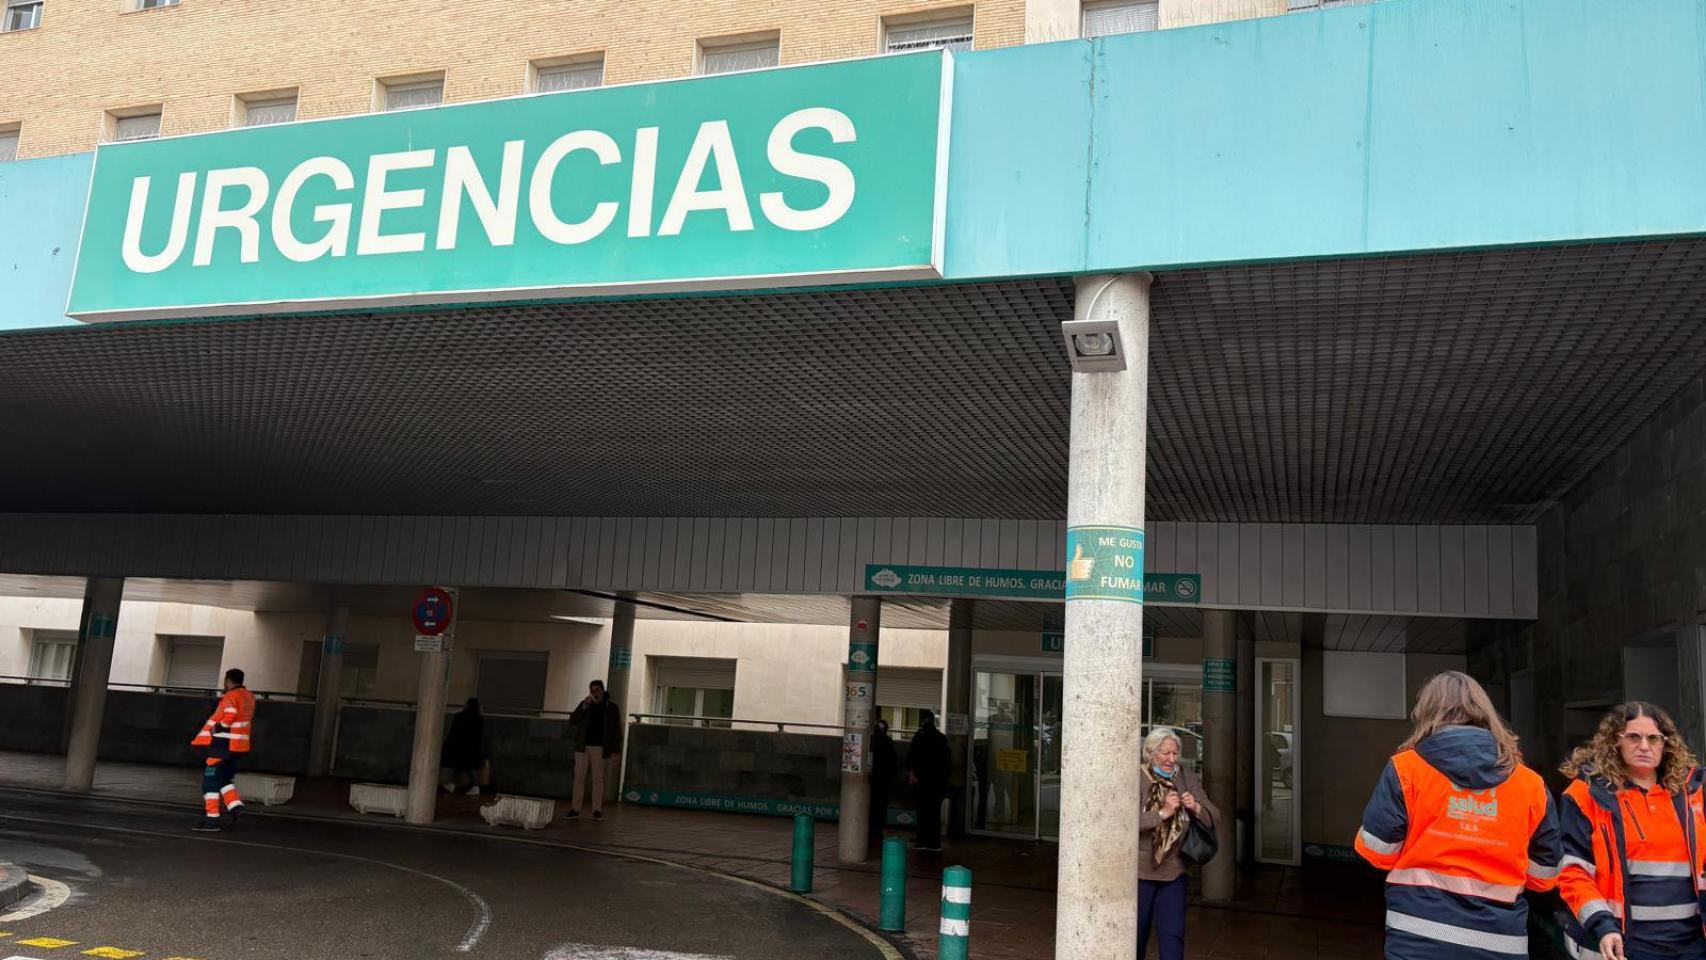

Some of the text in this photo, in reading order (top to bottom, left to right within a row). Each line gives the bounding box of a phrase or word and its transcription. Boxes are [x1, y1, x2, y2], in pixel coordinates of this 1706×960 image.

[122, 107, 857, 273] URGENCIAS
[1099, 537, 1115, 547] ME
[1114, 555, 1134, 568] NO
[908, 573, 935, 585] ZONA
[938, 575, 964, 586] LIBRE
[969, 576, 981, 587] DE
[985, 577, 1026, 589] HUMOS.
[1030, 578, 1066, 590] GRACIA
[675, 796, 697, 805] ZONA
[725, 799, 734, 808] DE
[1448, 794, 1497, 816] salud
